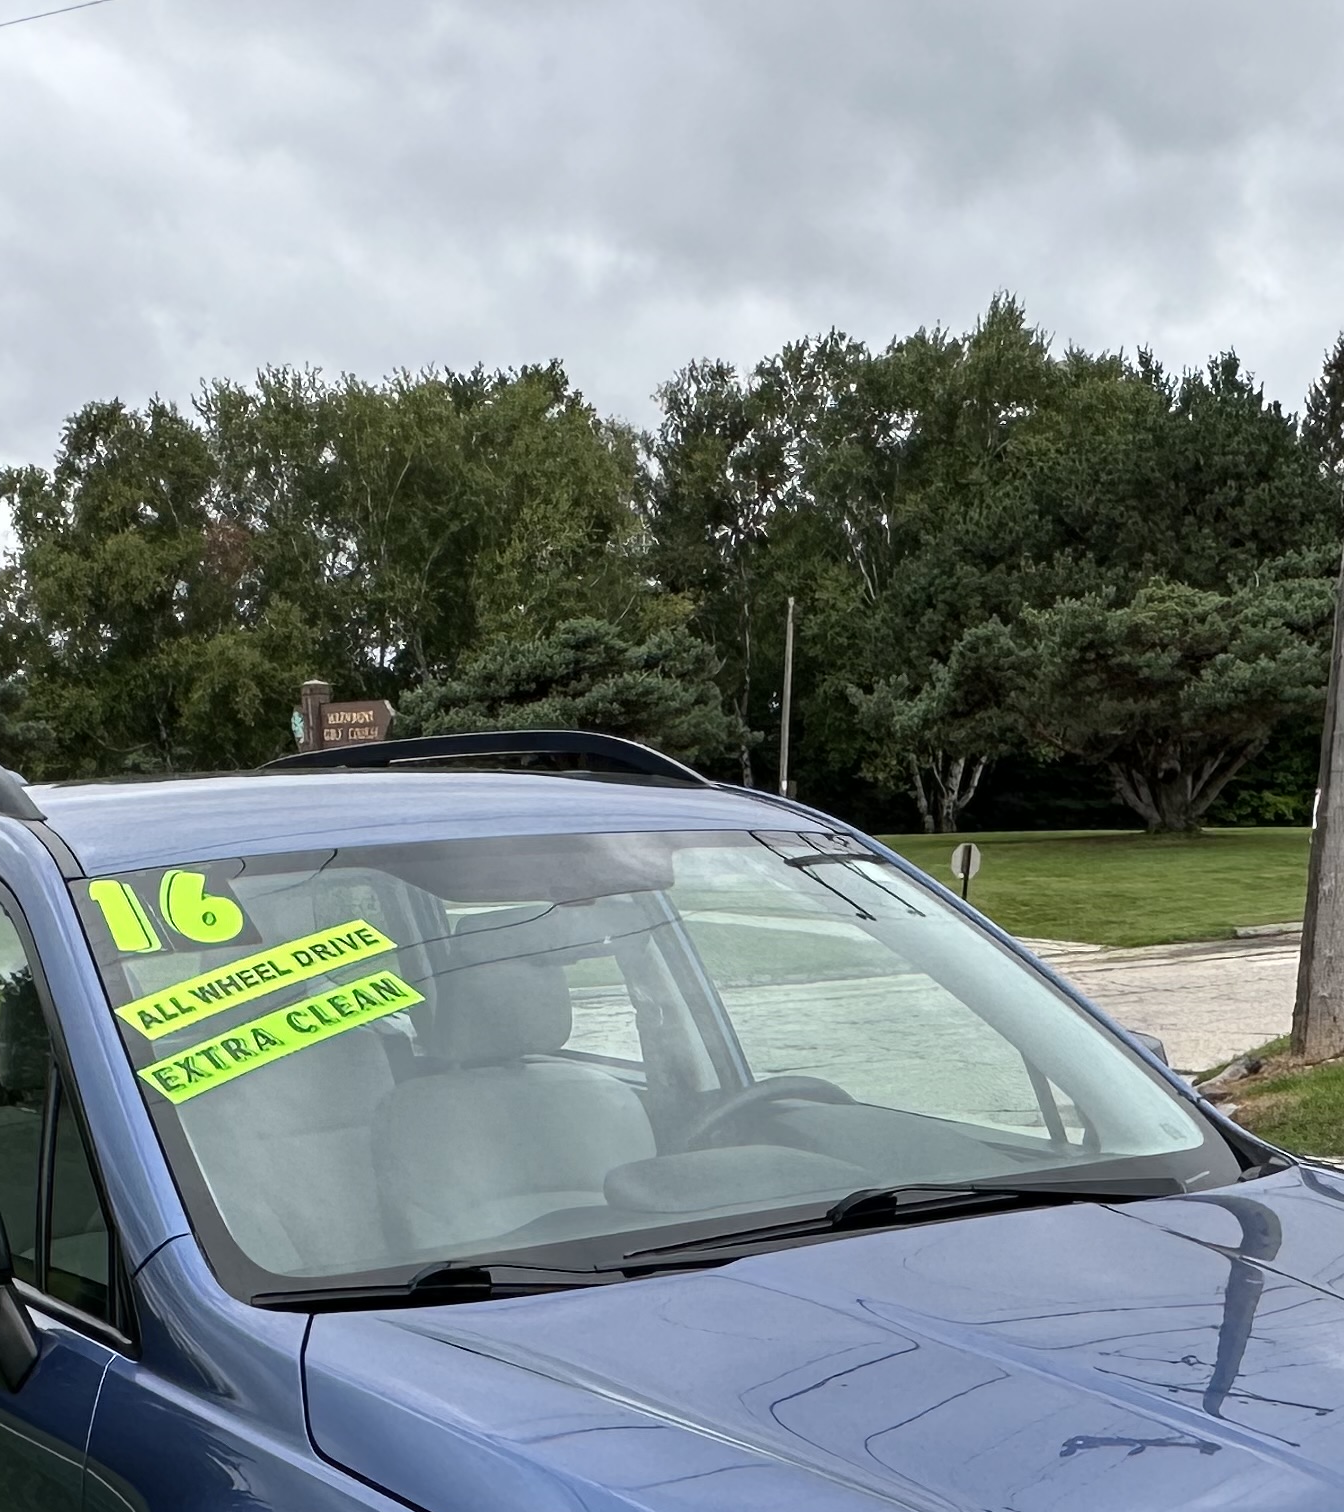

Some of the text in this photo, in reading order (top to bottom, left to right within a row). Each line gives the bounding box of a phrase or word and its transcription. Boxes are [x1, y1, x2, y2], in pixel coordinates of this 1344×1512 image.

[88, 869, 244, 953] 16
[137, 927, 381, 1031] ALL WHEEL DRIVE
[151, 977, 410, 1094] EXTRA CLEAN
